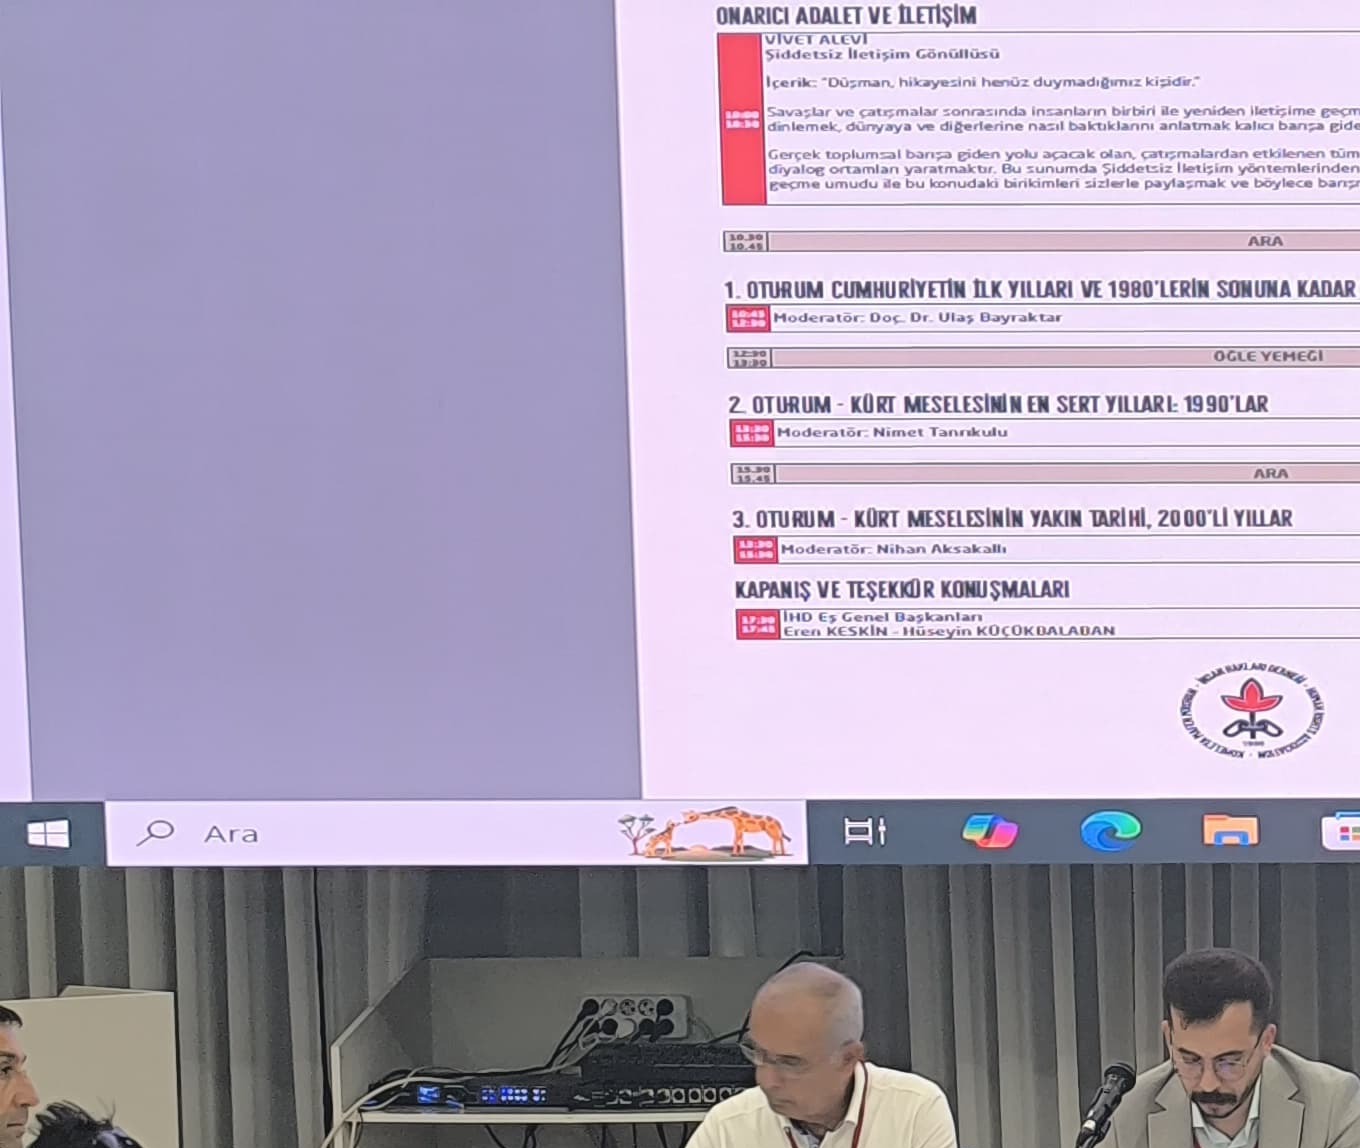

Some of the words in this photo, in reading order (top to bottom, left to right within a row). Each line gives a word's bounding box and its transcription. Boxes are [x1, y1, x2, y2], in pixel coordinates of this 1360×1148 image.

[715, 5, 790, 25] ONARICI
[794, 5, 865, 25] ADALET
[867, 6, 893, 25] VE
[897, 3, 978, 27] İLETİŞİM
[764, 48, 844, 61] Şiddetsiz
[847, 47, 911, 62] İletişim
[915, 48, 1001, 59] Gönüllüsü
[1248, 235, 1284, 246] ARA
[723, 281, 742, 299] 1.
[745, 281, 825, 299] OTURUM
[830, 280, 967, 299] CUMHURİYETİN
[971, 280, 1004, 298] İLK
[1007, 280, 1074, 298] YILLARI
[1079, 280, 1104, 298] VE
[1107, 280, 1211, 298] 1980'LERİN
[1215, 280, 1293, 298] SONUNA
[1296, 280, 1357, 298] KADAR
[773, 313, 866, 323] Moderatör:
[869, 312, 906, 324] Doç.
[909, 312, 934, 323] Dr.
[938, 312, 975, 324] Ulaş
[979, 312, 1063, 324] Bayraktar
[727, 396, 748, 414] 2.
[751, 396, 832, 414] OTURUM
[849, 394, 898, 414] KÜRT
[903, 394, 1023, 413] MESELESİNİN
[1026, 395, 1051, 413] EN
[1055, 395, 1102, 413] SERT
[1104, 395, 1180, 413] YILLARI:
[1182, 395, 1270, 413] 1990'LAR
[776, 426, 870, 437] Moderatör:
[872, 426, 925, 437] Nimet
[1253, 468, 1289, 479] ARA
[731, 510, 752, 528] 3.
[755, 510, 836, 528] OTURUM
[853, 508, 901, 528] KÜRT
[906, 508, 1025, 528] MESELESİNİN
[1029, 510, 1083, 527] YAKIN
[1087, 508, 1153, 528] TARİHİ,
[1156, 508, 1229, 527] 2000'Lİ
[1232, 509, 1294, 527] YILLAR
[780, 544, 873, 554] Moderatör:
[876, 544, 927, 554] Nihan
[930, 544, 1008, 554] Aksakallı
[734, 581, 812, 601] KAPANIŞ
[815, 580, 842, 599] VE
[845, 579, 936, 601] TEŞEKKÜR
[939, 580, 1071, 599] KONUŞMALARI
[783, 611, 814, 622] İHD
[817, 611, 838, 624] Eş
[841, 611, 890, 622] Genel
[894, 612, 984, 622] Başkanları
[783, 626, 822, 636] Eren
[826, 625, 889, 636] KESKİN
[902, 626, 973, 638] Hüseyin
[204, 824, 259, 843] Ara
